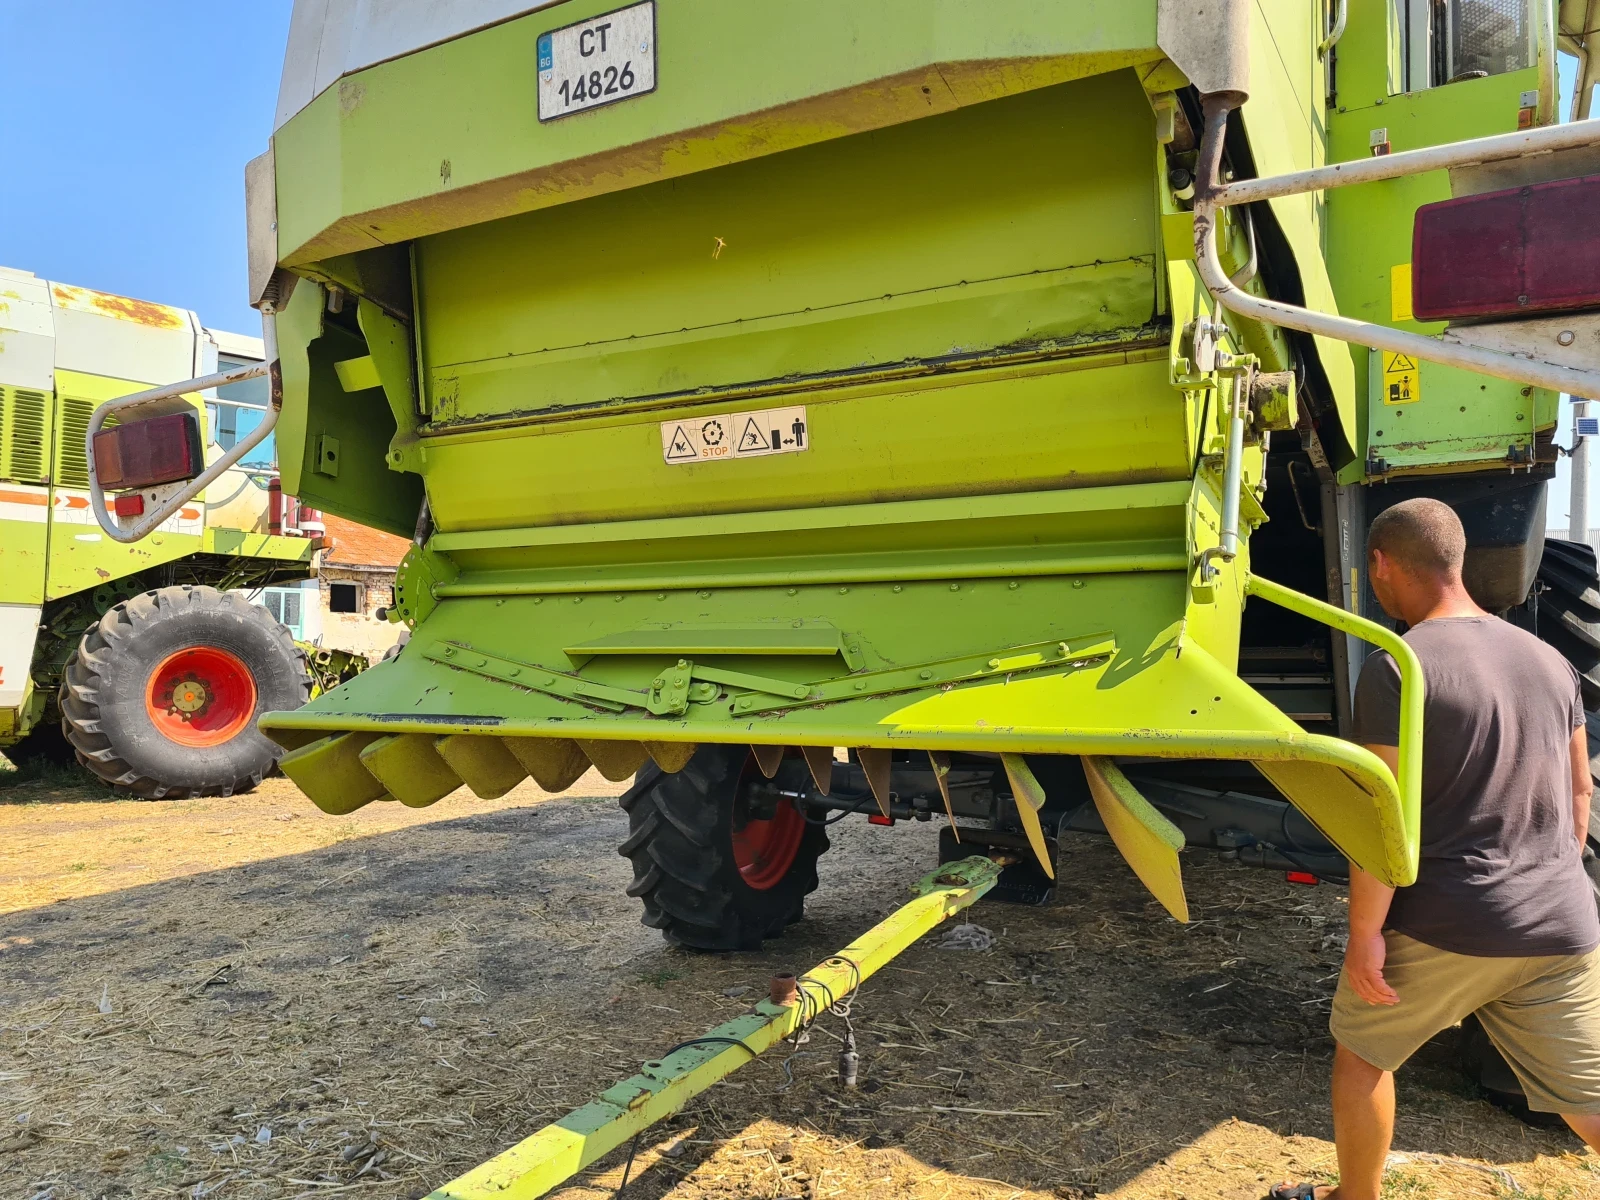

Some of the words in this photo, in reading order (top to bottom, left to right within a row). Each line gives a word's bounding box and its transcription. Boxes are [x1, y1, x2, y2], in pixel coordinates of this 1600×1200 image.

[579, 23, 612, 57] CT
[540, 56, 551, 68] BG
[558, 60, 635, 107] 14826
[702, 446, 728, 458] STOP
